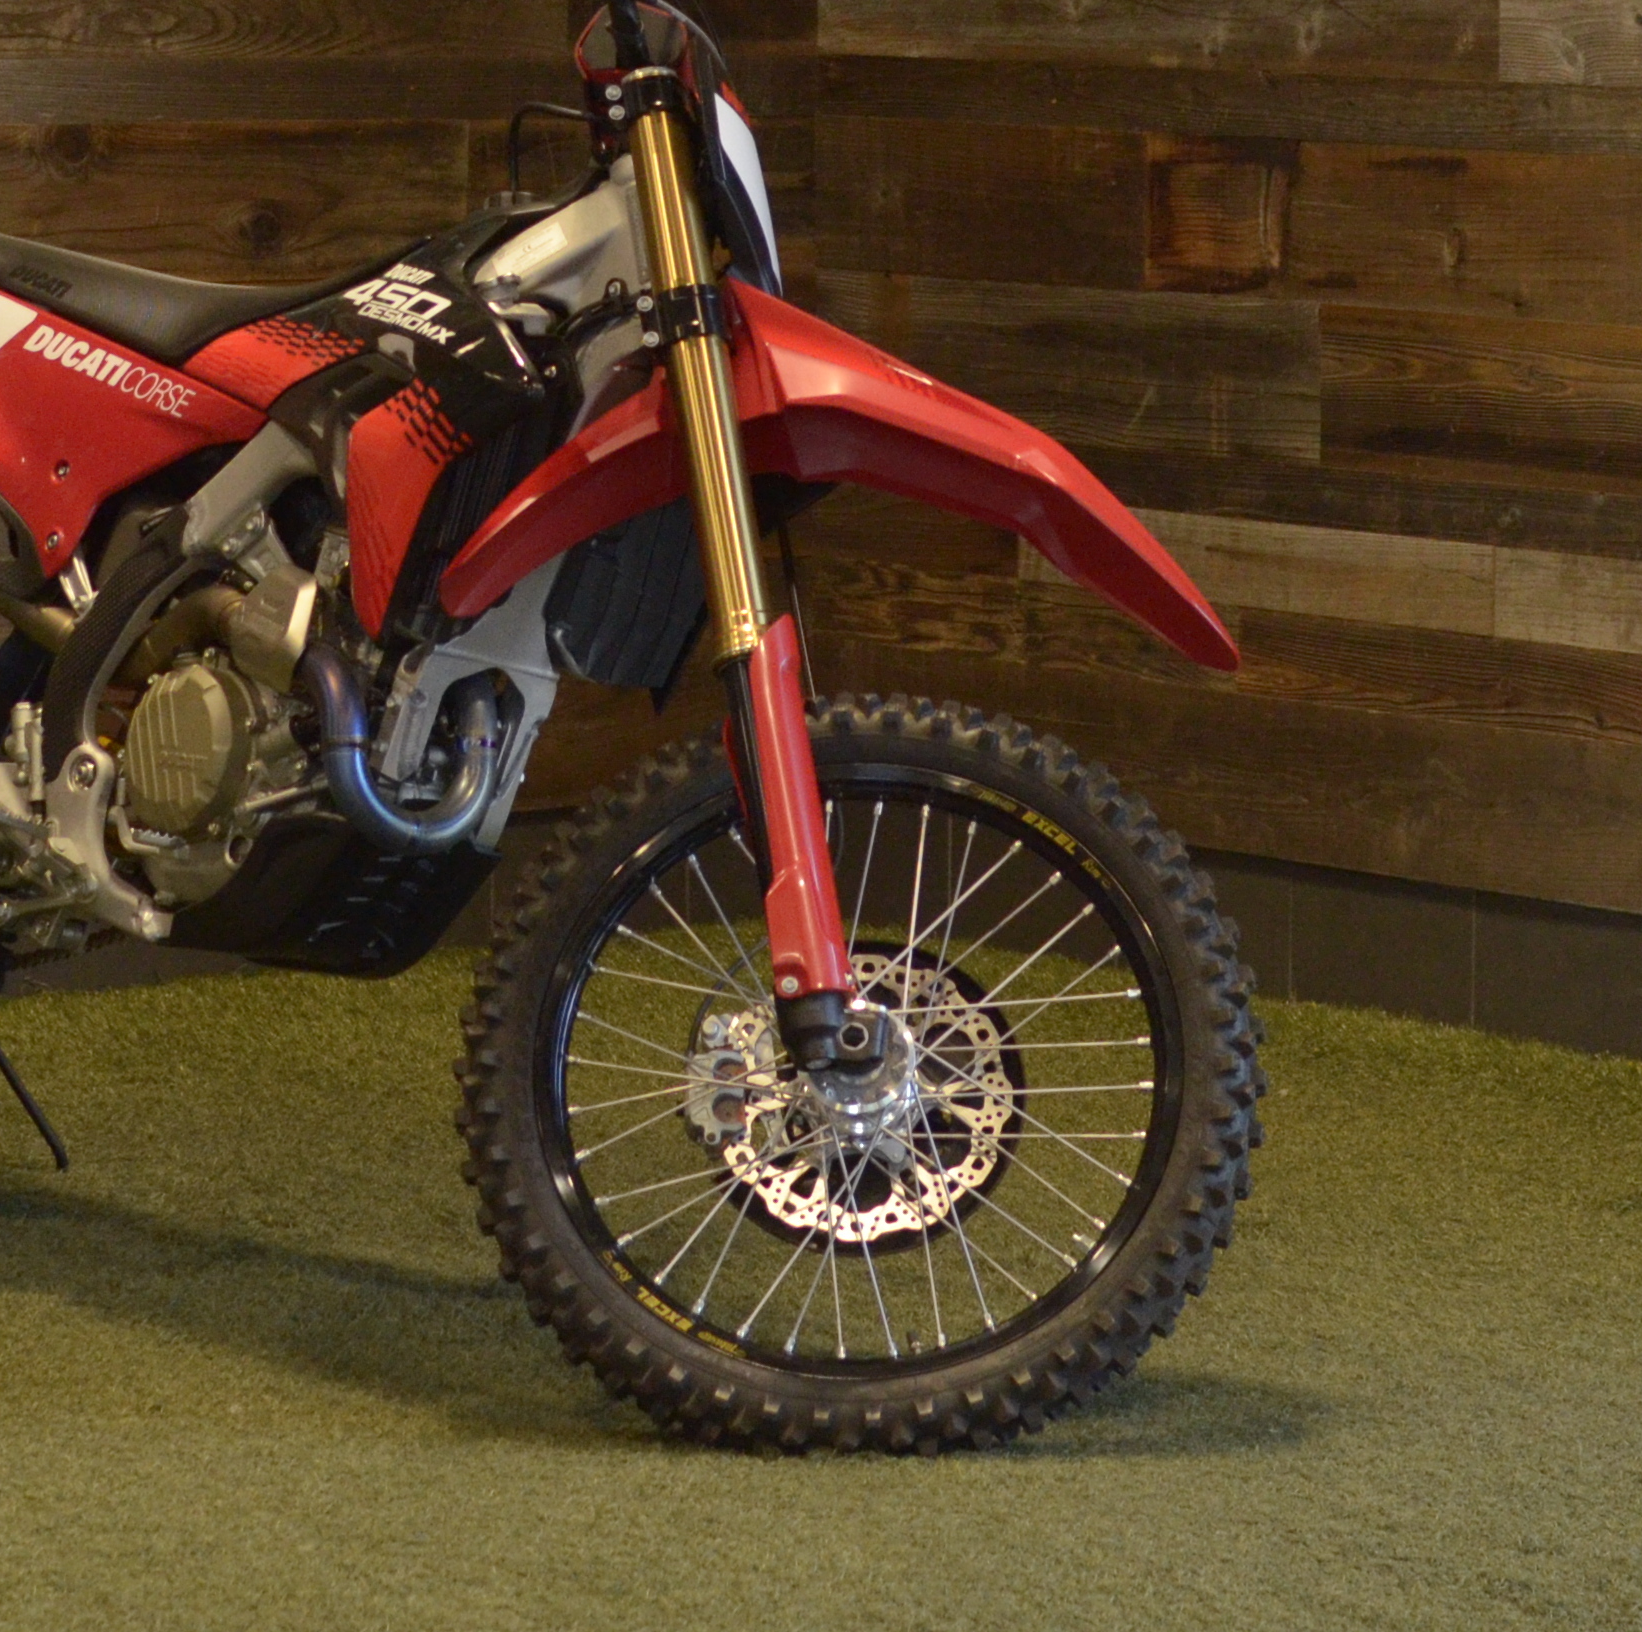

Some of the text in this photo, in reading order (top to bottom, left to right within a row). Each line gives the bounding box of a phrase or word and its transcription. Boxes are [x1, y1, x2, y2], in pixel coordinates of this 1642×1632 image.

[384, 263, 436, 285] DUCATI
[343, 278, 452, 321] 450
[1021, 810, 1078, 856] EXCEL
[636, 1285, 694, 1332] EXCEL
